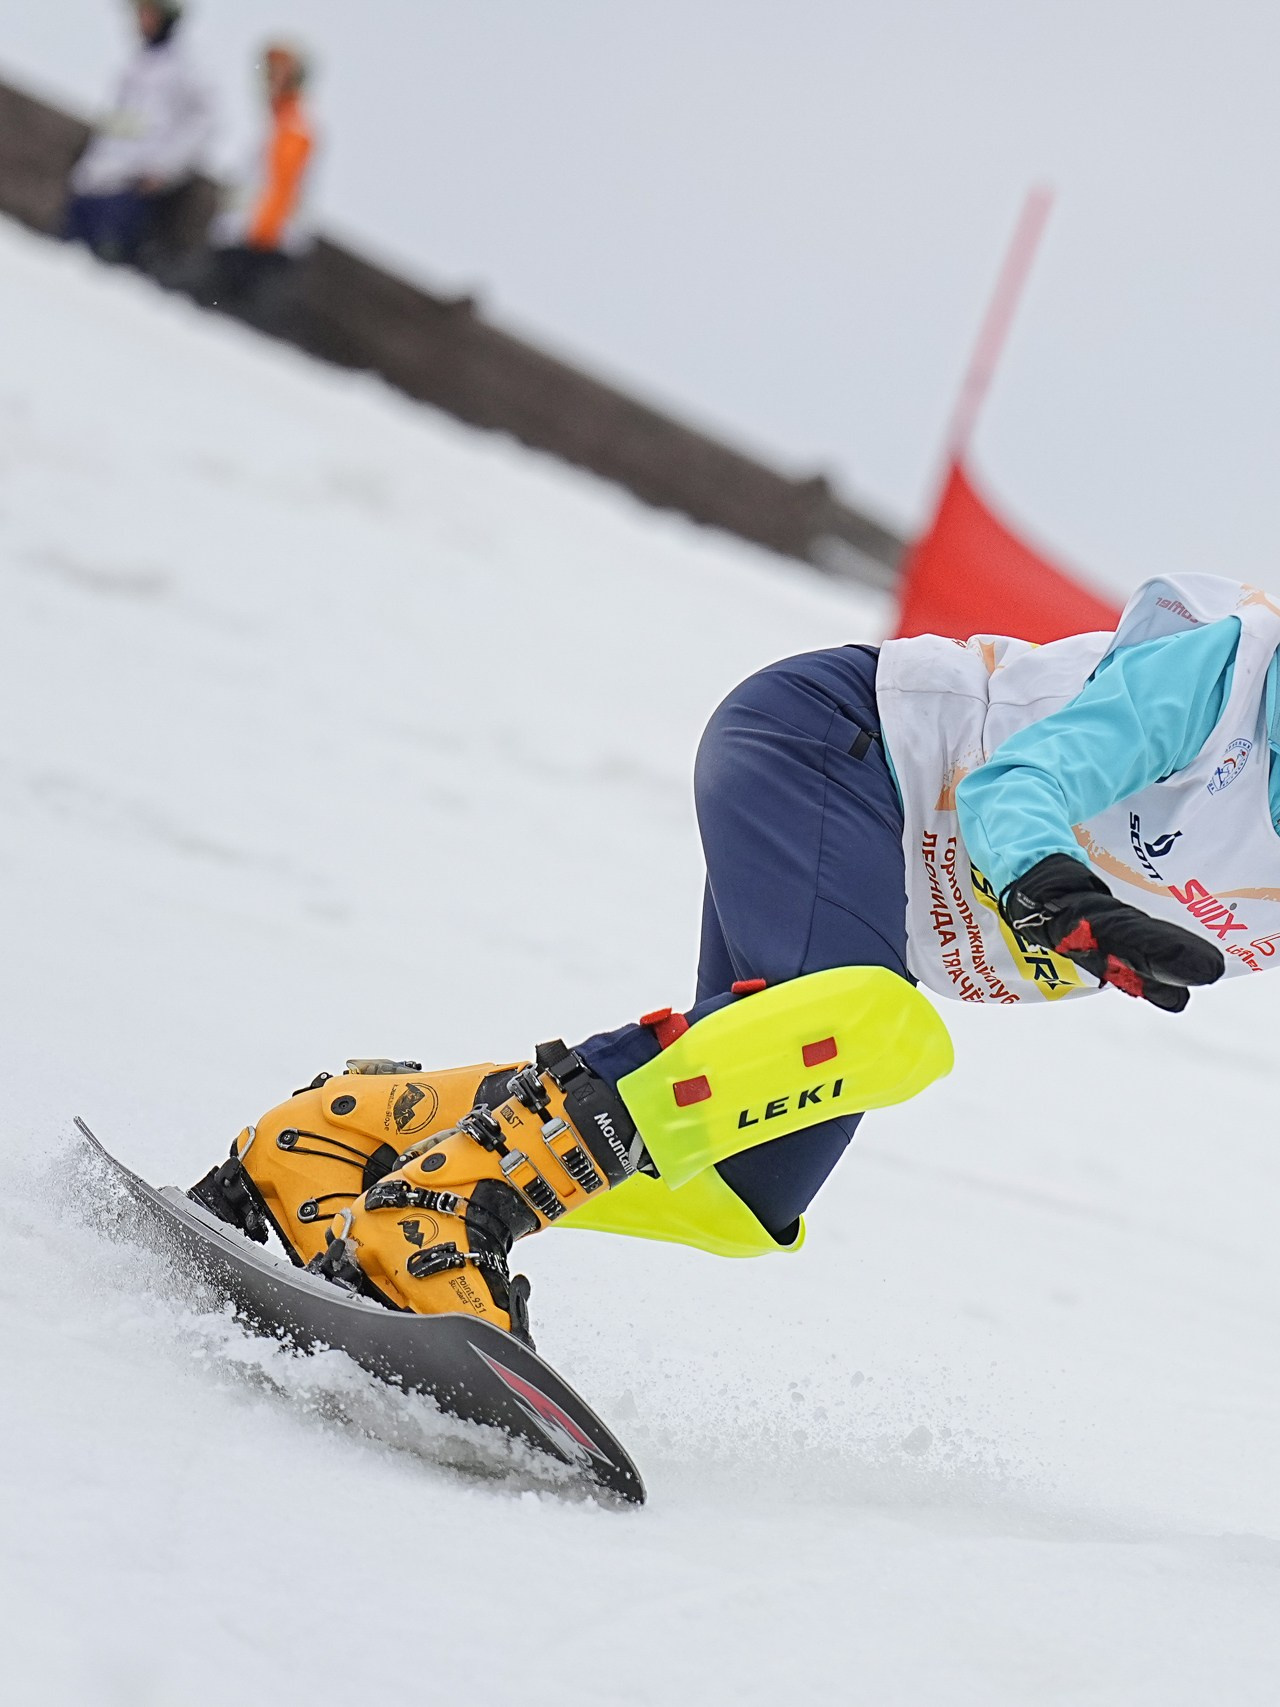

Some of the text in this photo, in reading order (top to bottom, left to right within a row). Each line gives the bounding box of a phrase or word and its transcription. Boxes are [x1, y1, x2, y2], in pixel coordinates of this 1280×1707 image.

[1130, 812, 1163, 881] SCOTT
[922, 830, 957, 947] ЛЕОНИДА
[737, 1078, 844, 1129] LEKI
